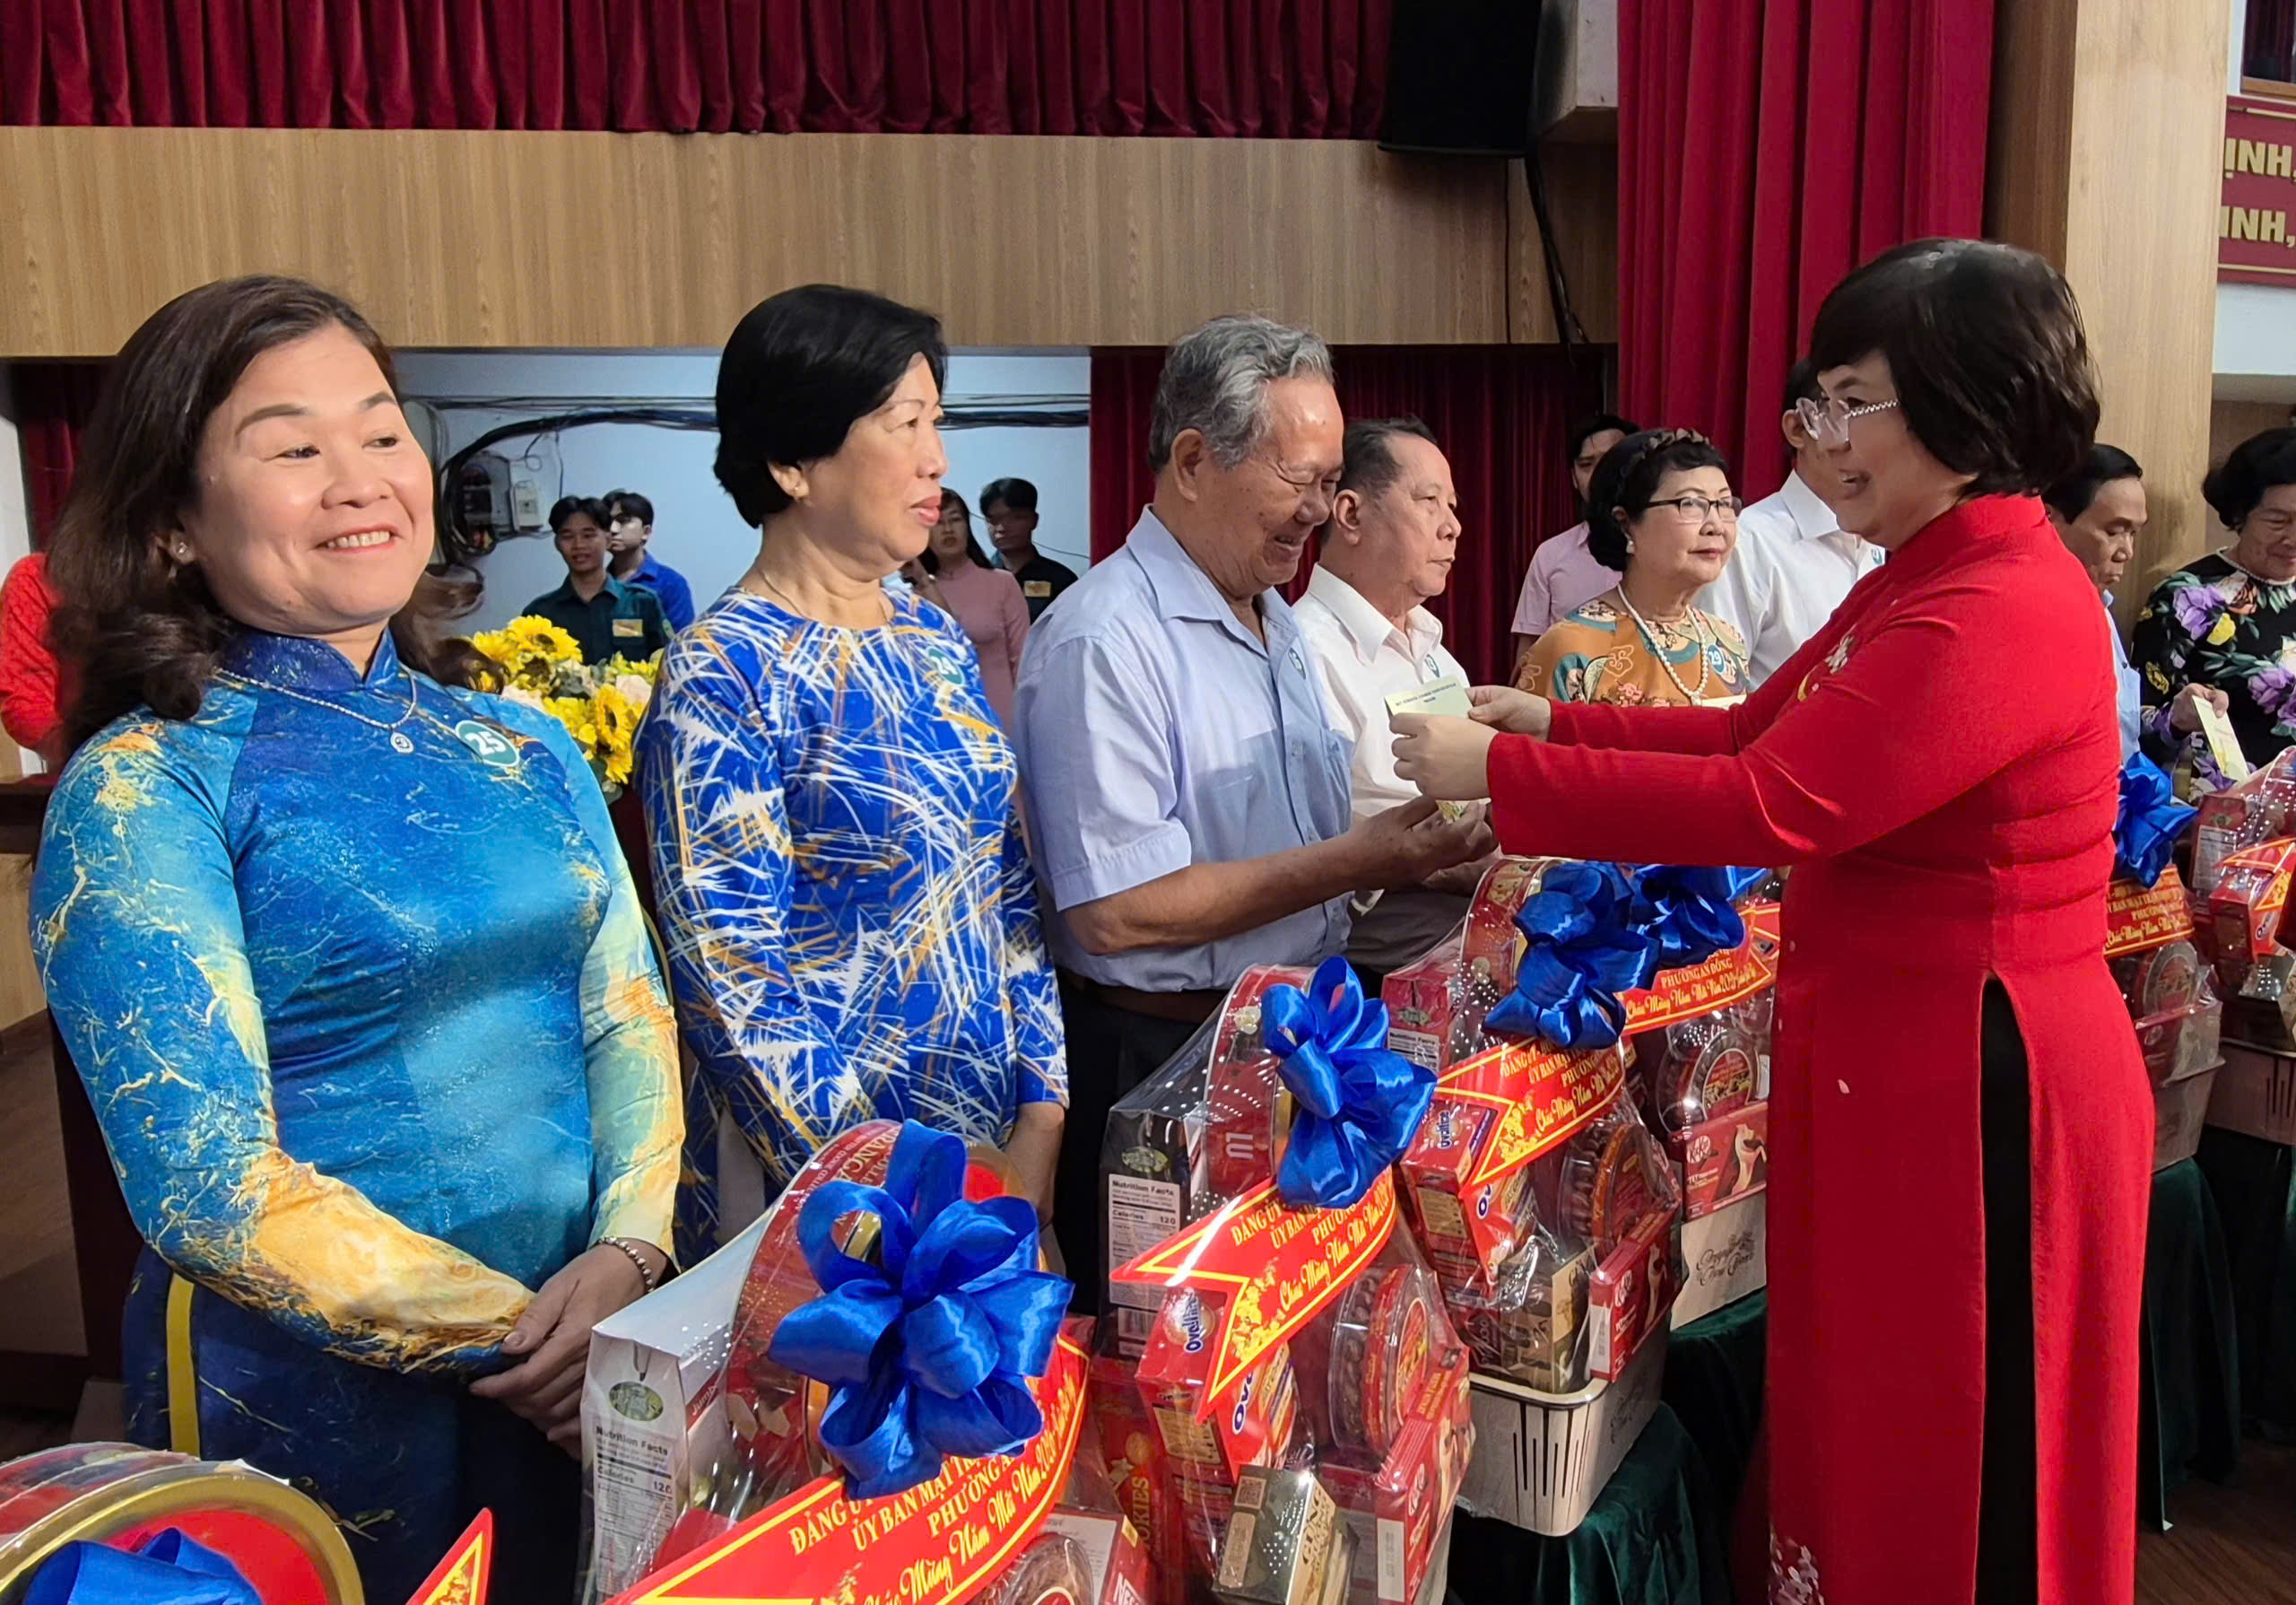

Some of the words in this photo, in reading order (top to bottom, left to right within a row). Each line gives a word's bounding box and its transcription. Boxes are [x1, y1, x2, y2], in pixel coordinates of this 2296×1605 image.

[1708, 650, 1722, 666] 29
[465, 731, 507, 755] 25
[1112, 1180, 1149, 1192] Nutrition
[1151, 1185, 1174, 1197] Facts
[1112, 1209, 1144, 1221] Calories
[1159, 1215, 1177, 1225] 120
[1326, 1236, 1350, 1268] Năm
[596, 1426, 638, 1445] Nutrition
[641, 1440, 668, 1456] Facts
[597, 1465, 635, 1484] Calories
[926, 1459, 1000, 1539] PHƯỜNG
[788, 1499, 847, 1555] ĐẢNG
[851, 1513, 880, 1550] ỦY
[879, 1487, 919, 1535] BAN
[900, 1556, 952, 1604] Mừng
[948, 1521, 990, 1566] Năm
